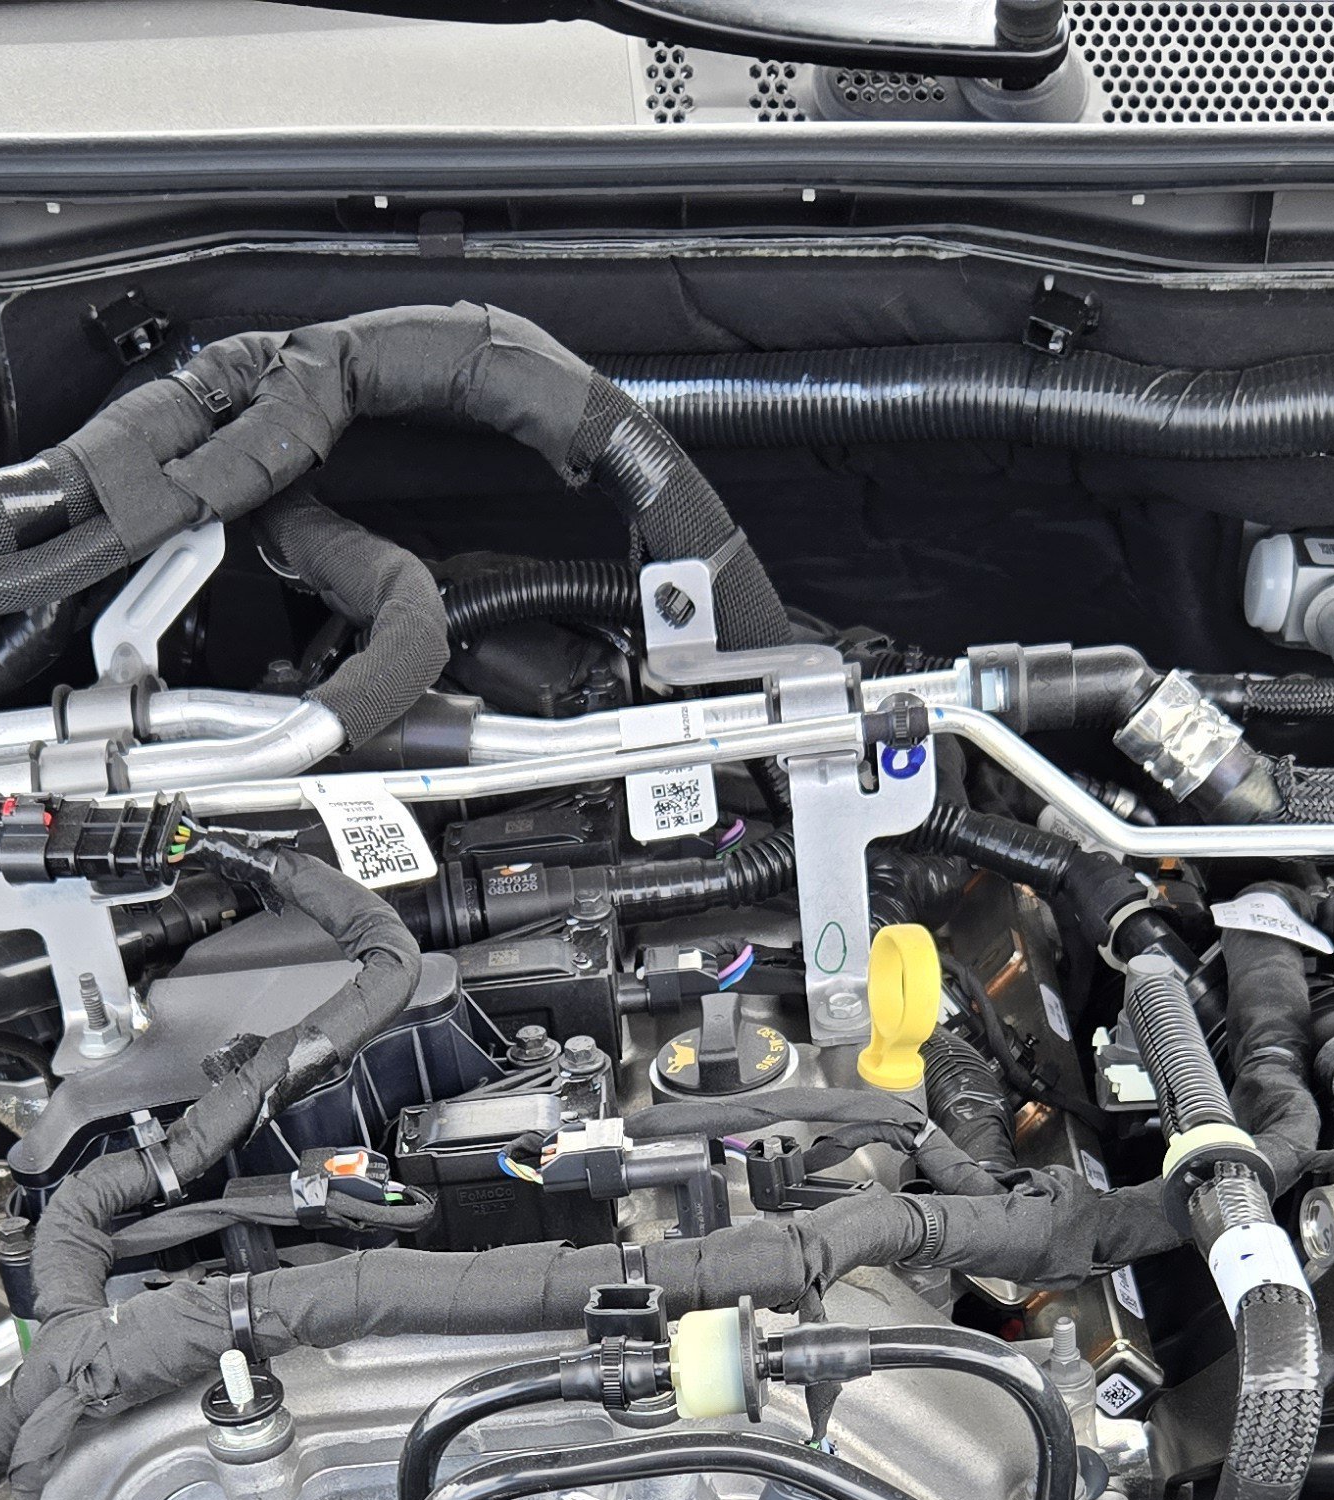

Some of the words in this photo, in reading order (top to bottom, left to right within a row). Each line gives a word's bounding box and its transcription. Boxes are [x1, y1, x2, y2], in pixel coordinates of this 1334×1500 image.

[488, 873, 538, 886] 250915
[488, 882, 539, 896] 081026
[459, 1187, 512, 1201] FoMoCo
